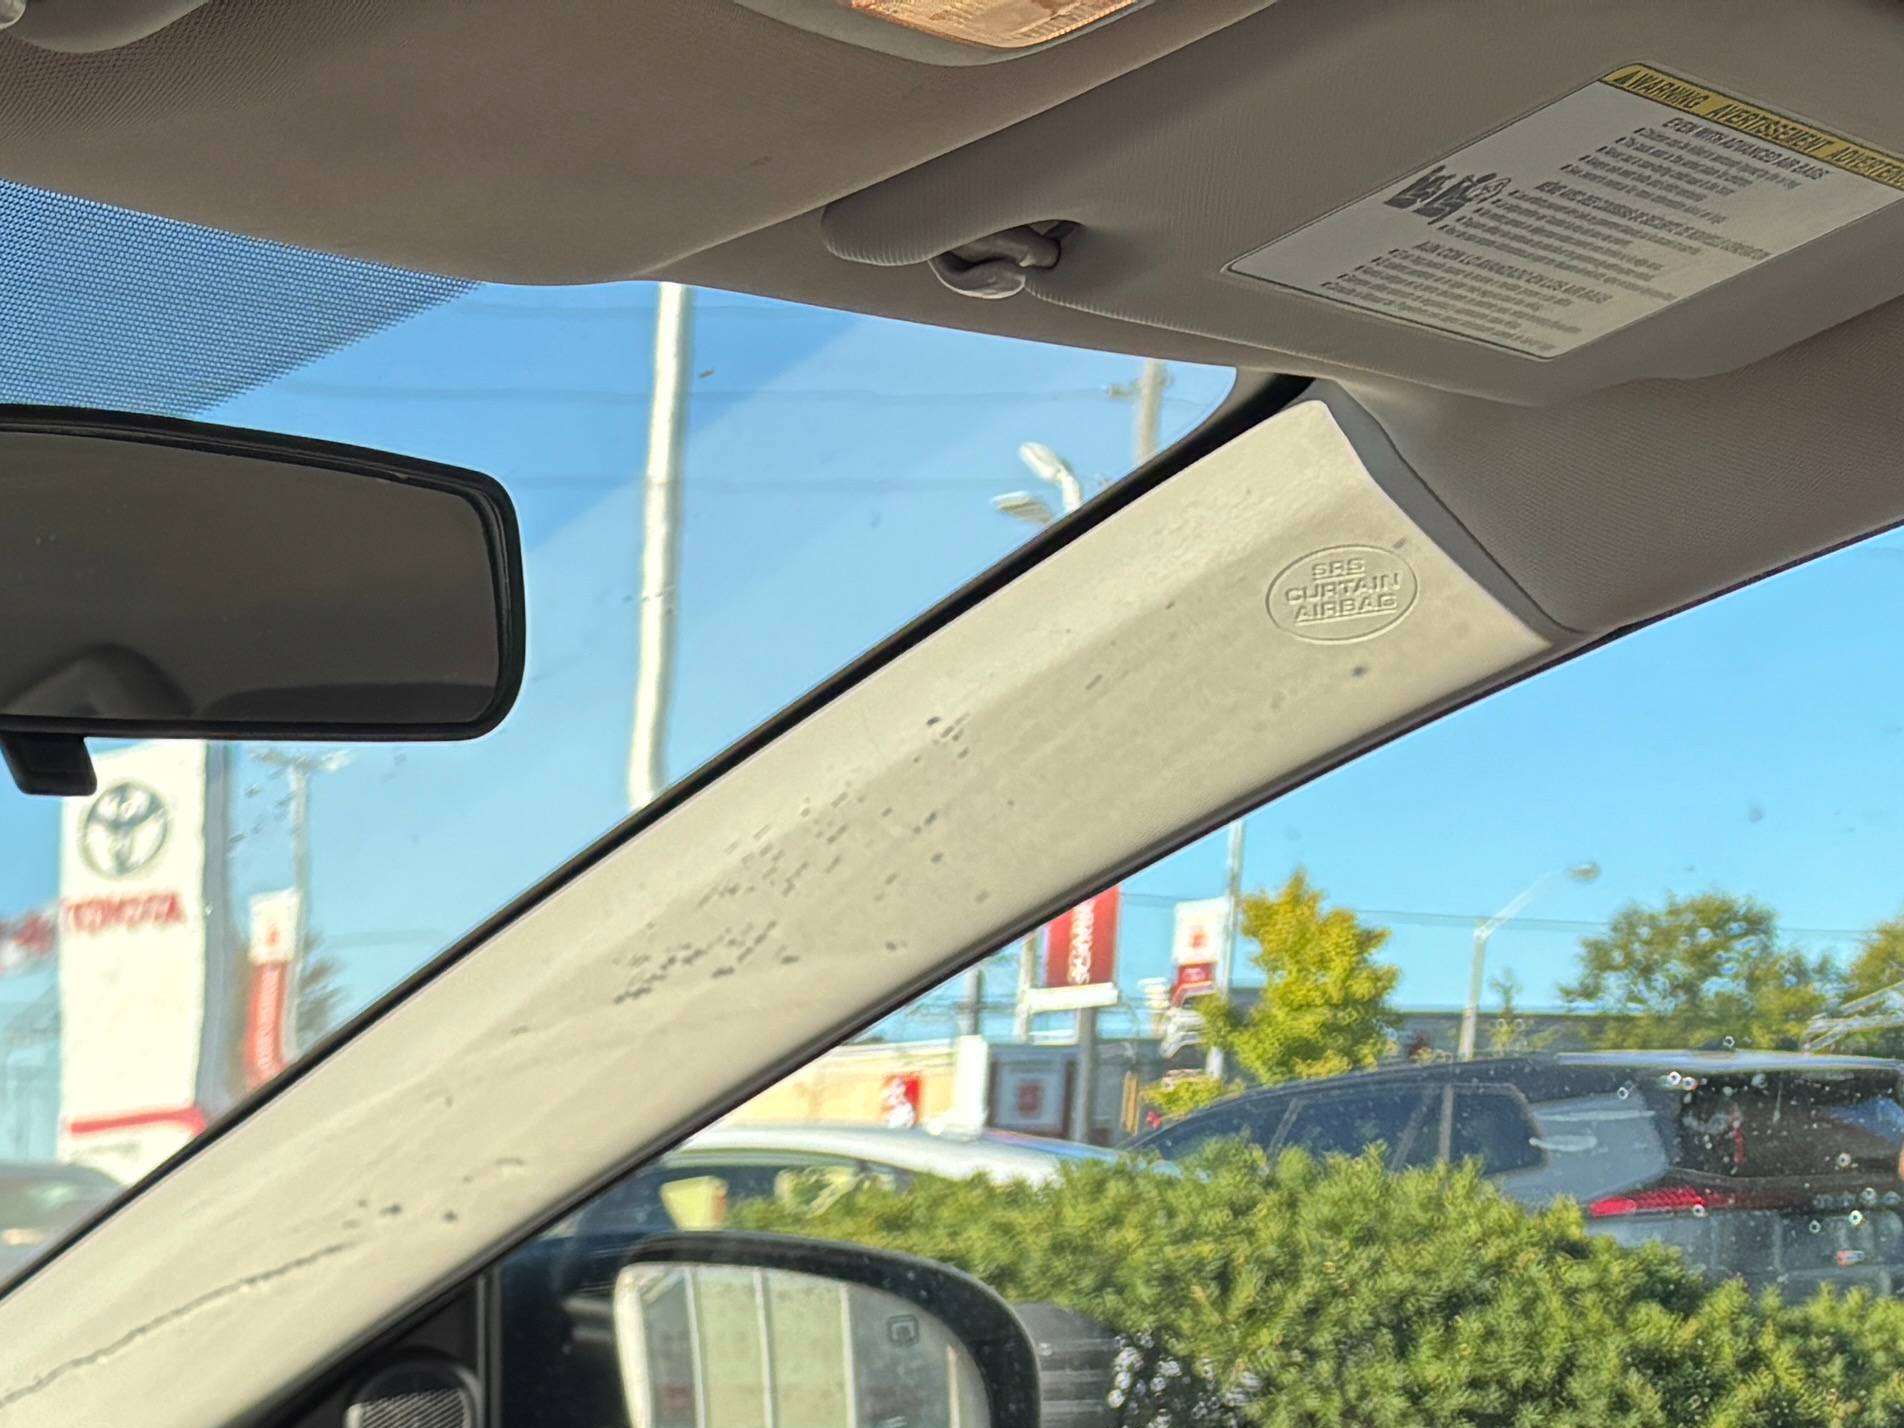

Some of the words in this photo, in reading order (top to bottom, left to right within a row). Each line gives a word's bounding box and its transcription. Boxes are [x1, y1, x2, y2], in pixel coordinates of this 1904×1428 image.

[1627, 73, 1709, 108] WARNING
[1705, 104, 1834, 152] AVERTISSEMENT
[1312, 558, 1365, 580] SRS
[1285, 572, 1400, 604] CURTAIN
[1295, 594, 1397, 623] AIRBAG
